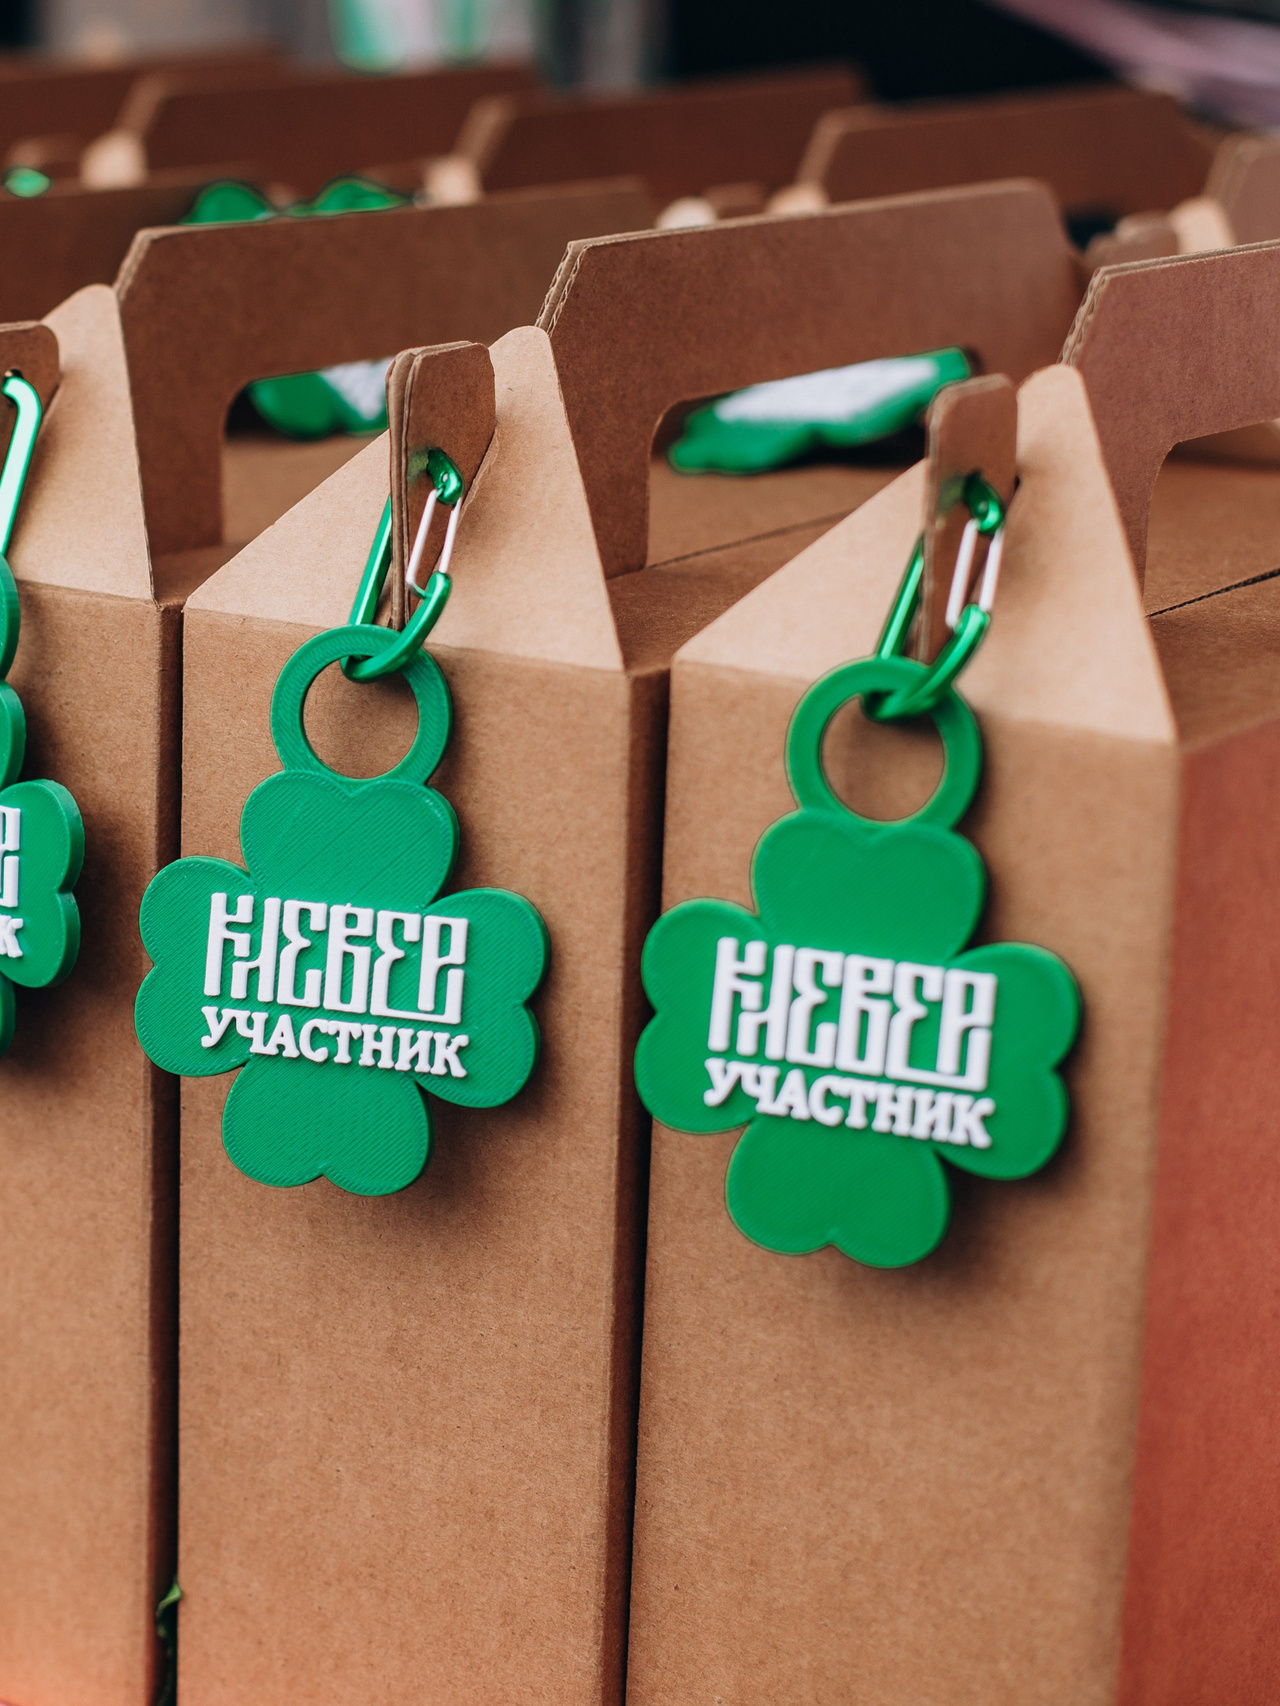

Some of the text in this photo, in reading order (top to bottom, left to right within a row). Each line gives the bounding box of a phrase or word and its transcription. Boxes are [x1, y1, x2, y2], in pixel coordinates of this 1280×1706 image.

[203, 891, 469, 1025] КЛЕВЕР
[707, 936, 998, 1092] КЛЕВЕР
[200, 1005, 469, 1078] УЧАСТНИК
[703, 1057, 996, 1149] УЧАСТНИК
